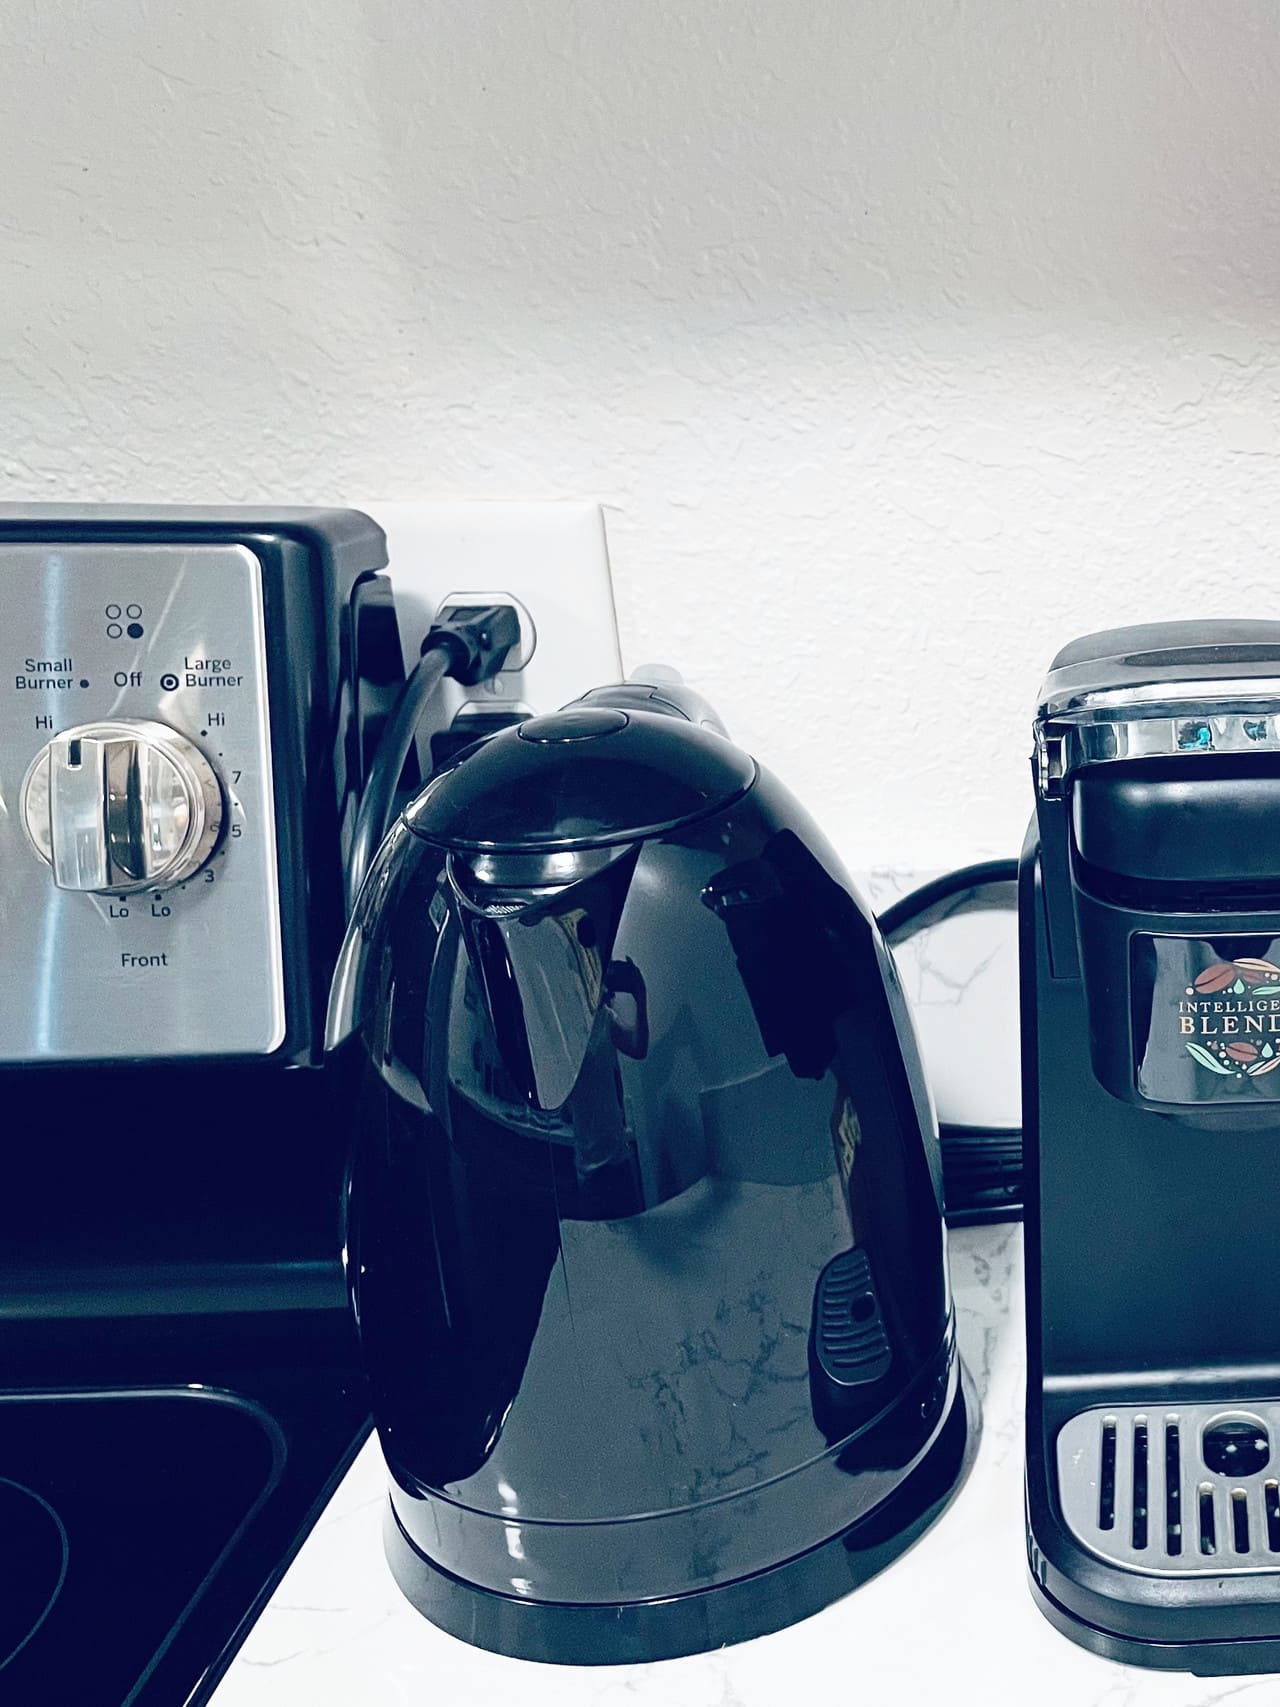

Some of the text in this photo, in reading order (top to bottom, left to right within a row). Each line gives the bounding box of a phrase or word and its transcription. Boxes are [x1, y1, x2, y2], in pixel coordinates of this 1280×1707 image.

[25, 658, 73, 673] Small
[185, 657, 232, 672] Large
[16, 676, 74, 690] Burner
[114, 672, 142, 688] Off
[186, 674, 244, 688] Burner
[36, 716, 54, 730] Hi
[208, 713, 226, 726] Hi
[232, 771, 241, 784] 7
[232, 825, 242, 838] 5
[204, 870, 215, 882] 3
[110, 904, 129, 918] Lo
[152, 904, 171, 918] Lo
[121, 953, 168, 968] Front
